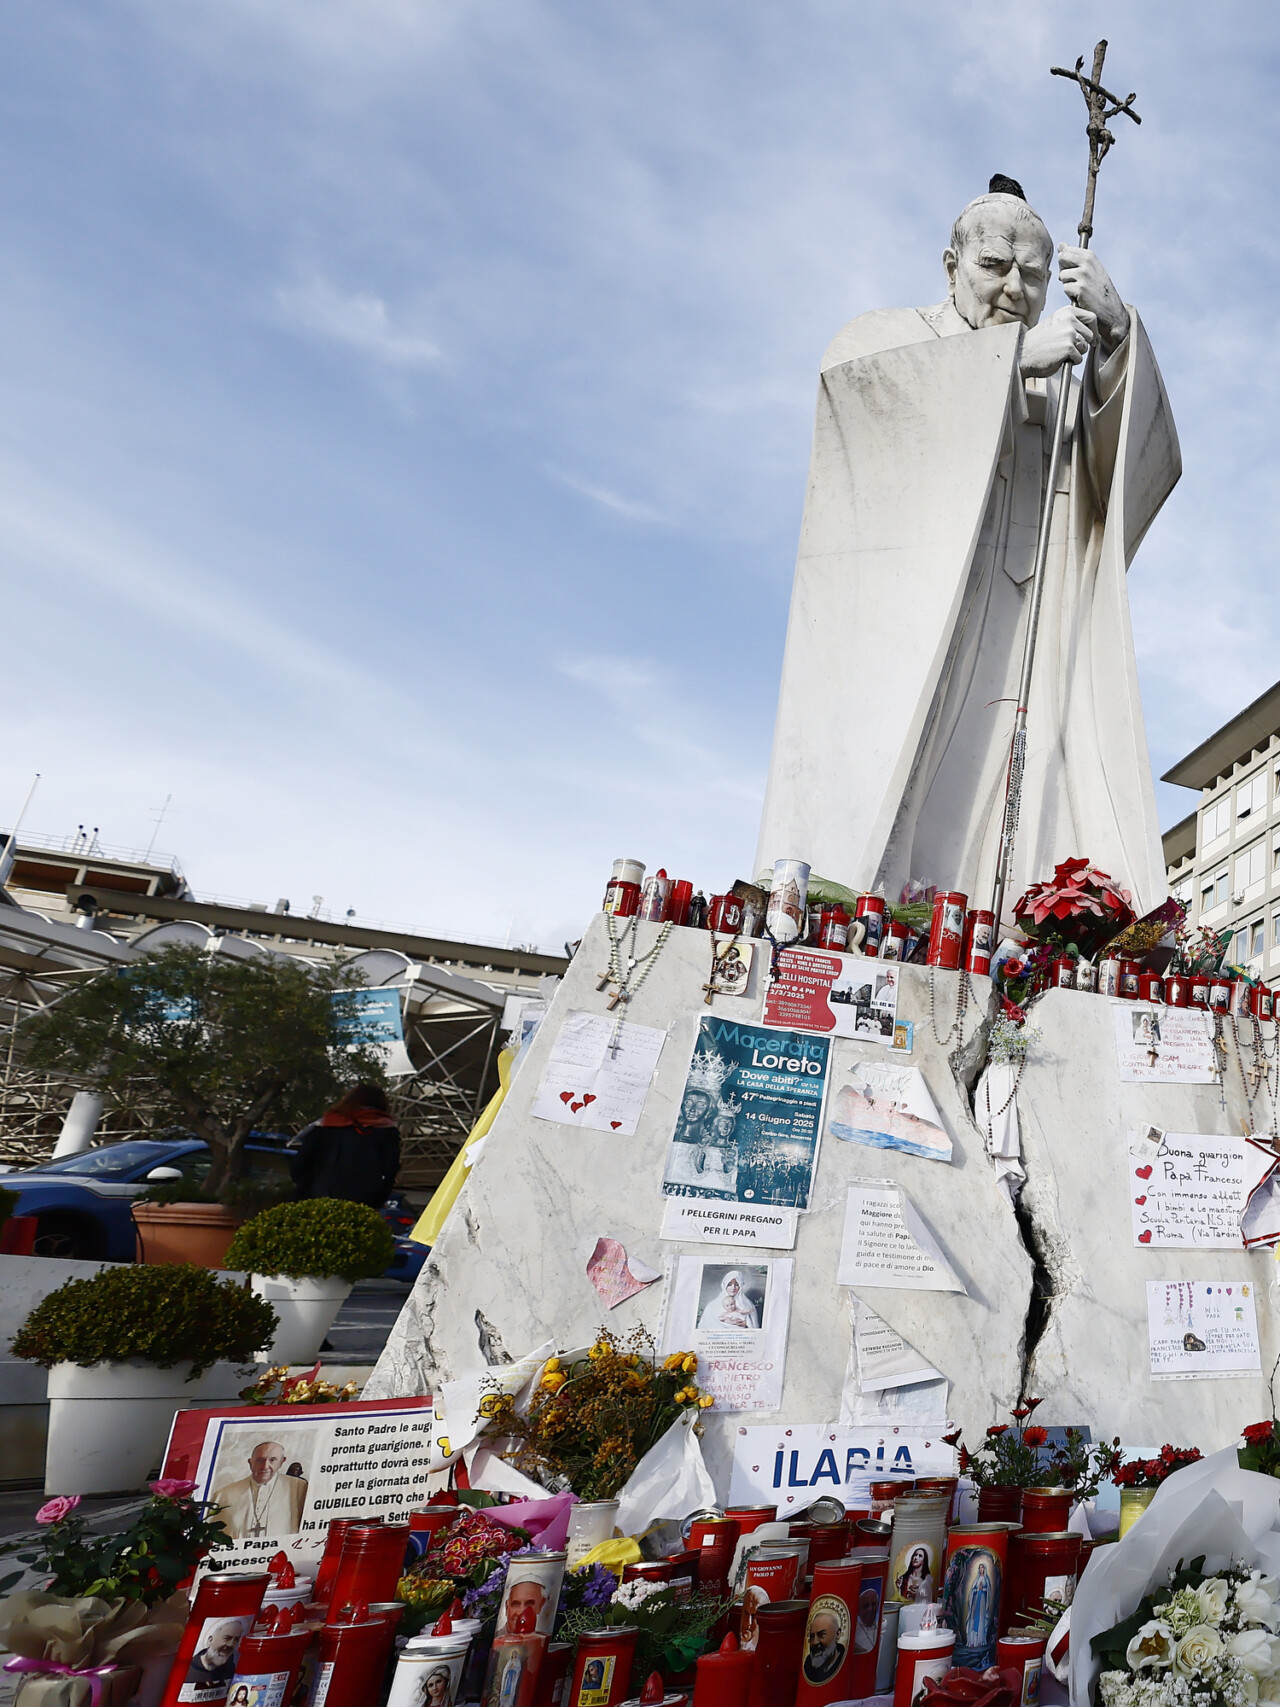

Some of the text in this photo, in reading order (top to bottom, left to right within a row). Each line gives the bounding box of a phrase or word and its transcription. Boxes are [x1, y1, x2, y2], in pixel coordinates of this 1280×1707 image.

[798, 975, 832, 988] HOSPITAL
[715, 1022, 825, 1060] Macerata
[752, 1049, 822, 1076] Loreto
[765, 1083, 784, 1091] DELLA
[786, 1086, 818, 1096] SPERANZA
[745, 1112, 814, 1128] 14 Giugno 2025
[1157, 1141, 1194, 1160] Buona
[1199, 1148, 1244, 1168] guarigion
[1164, 1161, 1193, 1187] Papa
[1147, 1185, 1167, 1198] Con
[1212, 1190, 1242, 1205] affett
[866, 1200, 888, 1208] ragazzi
[1164, 1202, 1186, 1212] bimbi
[687, 1209, 738, 1221] PELLEGRINI
[739, 1214, 782, 1225] PREGANO
[861, 1209, 892, 1218] Maggiore
[1140, 1211, 1170, 1224] Scuola
[872, 1221, 892, 1229] hanno
[703, 1226, 756, 1238] PER IL PAPA
[866, 1230, 886, 1238] salute
[1155, 1225, 1184, 1240] Roma
[863, 1240, 888, 1249] Signore
[856, 1250, 876, 1258] guida
[882, 1252, 915, 1261] testimone
[894, 1264, 916, 1272] amore
[708, 1360, 774, 1372] FRANCESCO
[699, 1375, 715, 1383] SEI
[334, 1426, 364, 1437] Santo
[368, 1424, 396, 1434] Padre
[400, 1422, 408, 1432] le
[331, 1444, 366, 1457] pronta
[368, 1440, 424, 1454] guarigione.
[320, 1461, 378, 1474] soprattutto
[381, 1457, 408, 1468] dovrà
[335, 1473, 428, 1492] per la giornata del
[314, 1492, 424, 1510] GIUBILEO LGBTQ che
[302, 1520, 316, 1530] ha
[244, 1540, 278, 1550] Papa
